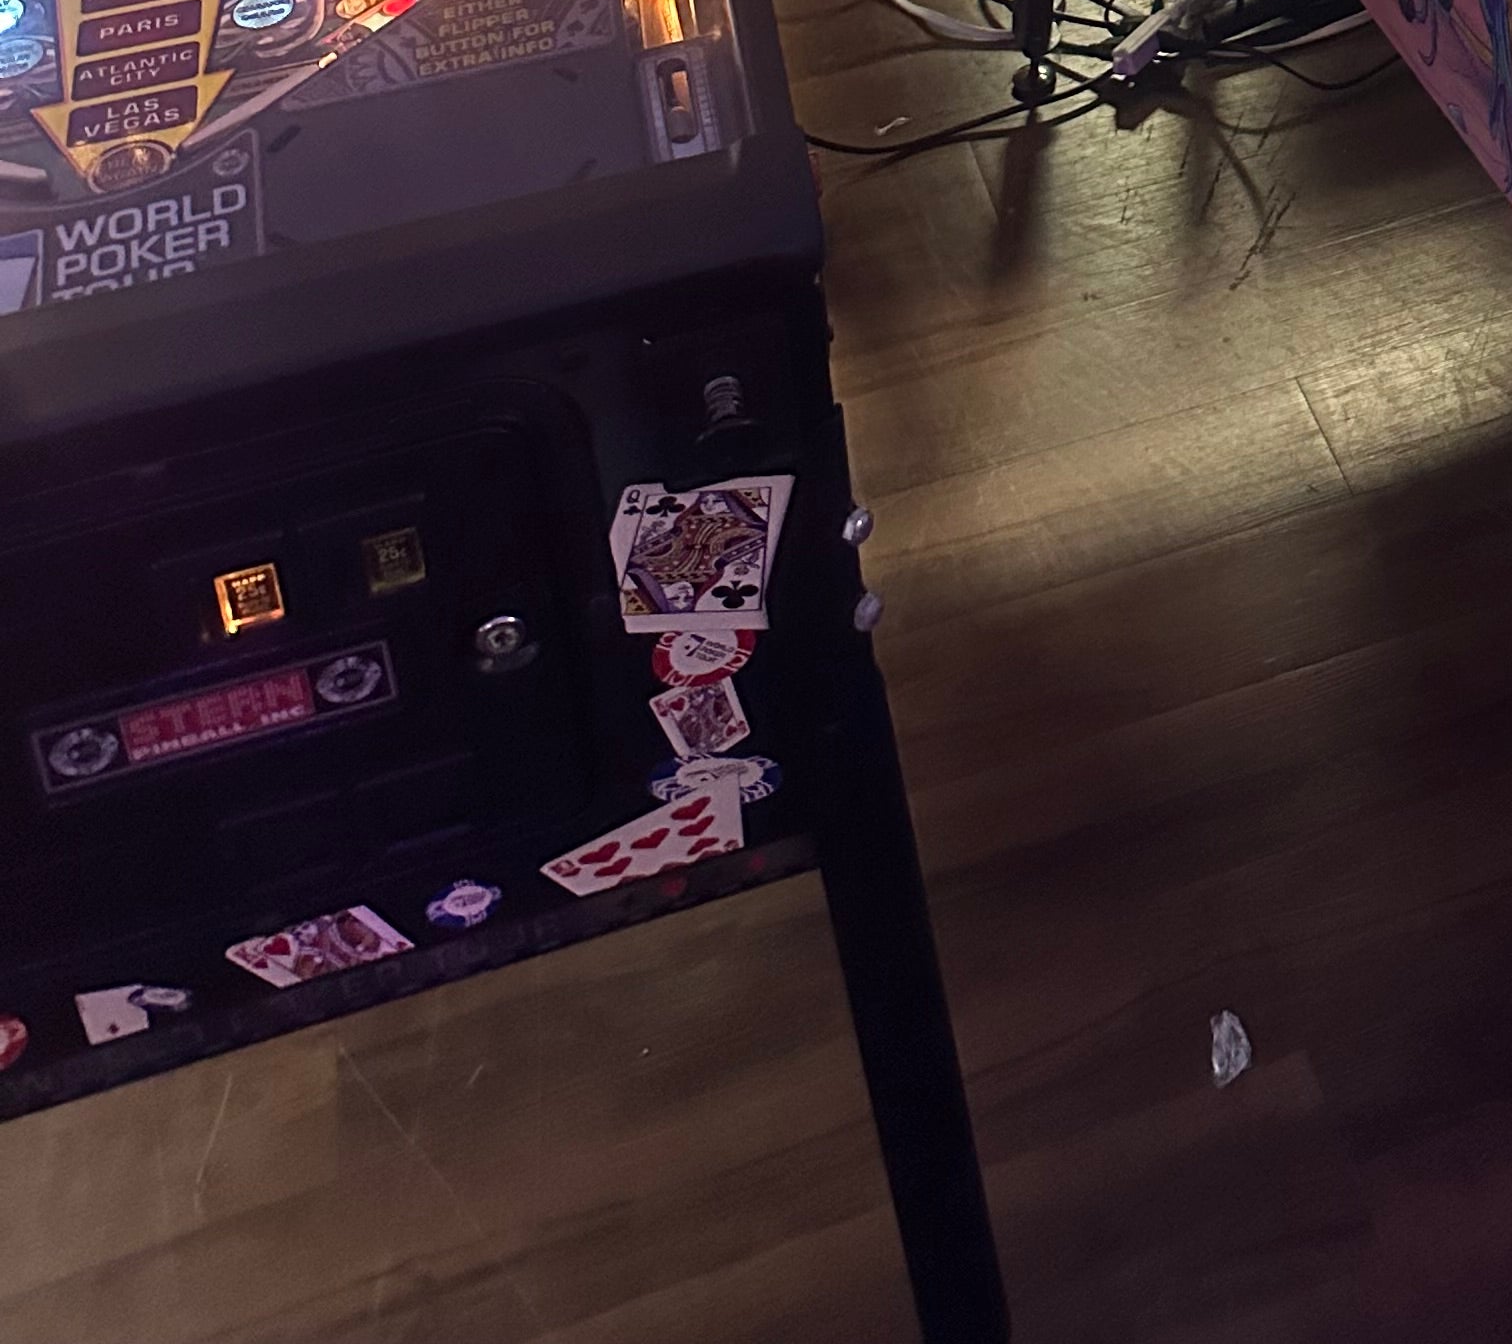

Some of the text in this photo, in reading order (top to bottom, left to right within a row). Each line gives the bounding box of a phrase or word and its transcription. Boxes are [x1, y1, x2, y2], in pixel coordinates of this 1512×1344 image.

[100, 13, 180, 41] PARIS
[438, 8, 529, 38] FLIPPER
[415, 20, 556, 60] BUTTON FOR
[78, 49, 193, 81] ATLANTIC
[418, 37, 554, 77] EXTRA INFO
[110, 66, 160, 86] CITY
[83, 107, 180, 139] VEGAS
[106, 97, 160, 120] LAS
[55, 183, 247, 252] WORLD
[55, 218, 230, 287] POKER
[626, 489, 641, 504] Q
[129, 671, 304, 746] STERN
[132, 721, 244, 760] PINBALL
